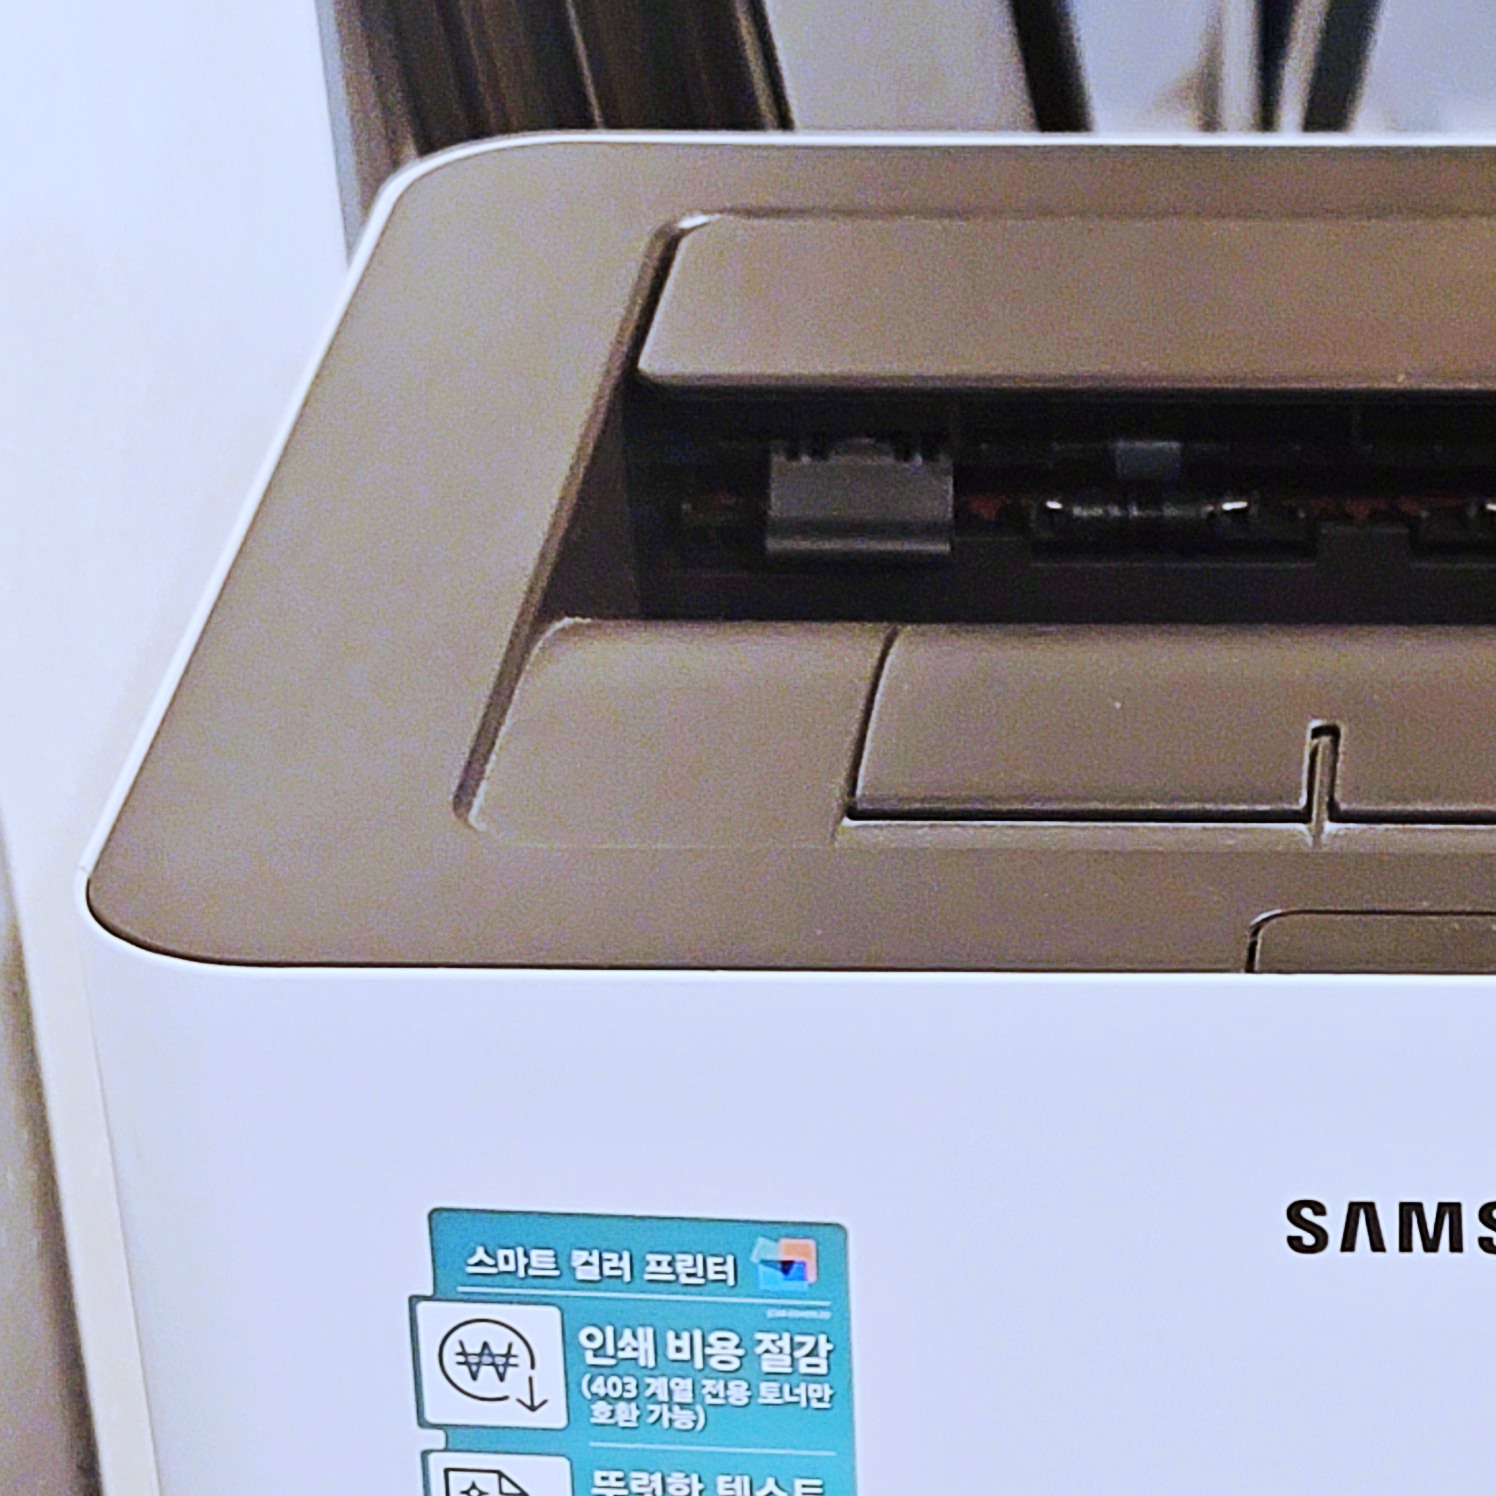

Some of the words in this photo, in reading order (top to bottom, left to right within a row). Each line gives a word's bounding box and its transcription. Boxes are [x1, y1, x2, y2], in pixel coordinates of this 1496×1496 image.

[465, 1246, 561, 1279] 스마트
[571, 1250, 631, 1283] 컬러
[643, 1253, 736, 1286] 프린터
[578, 1325, 656, 1368] 인쇄
[666, 1328, 745, 1371] 비용
[754, 1332, 834, 1375] 절감
[581, 1373, 637, 1398] (403
[644, 1377, 694, 1403] 계열
[701, 1379, 752, 1406] 전용
[757, 1381, 834, 1409] 토너만
[590, 1401, 641, 1428] 호환
[646, 1403, 706, 1431] 가능)
